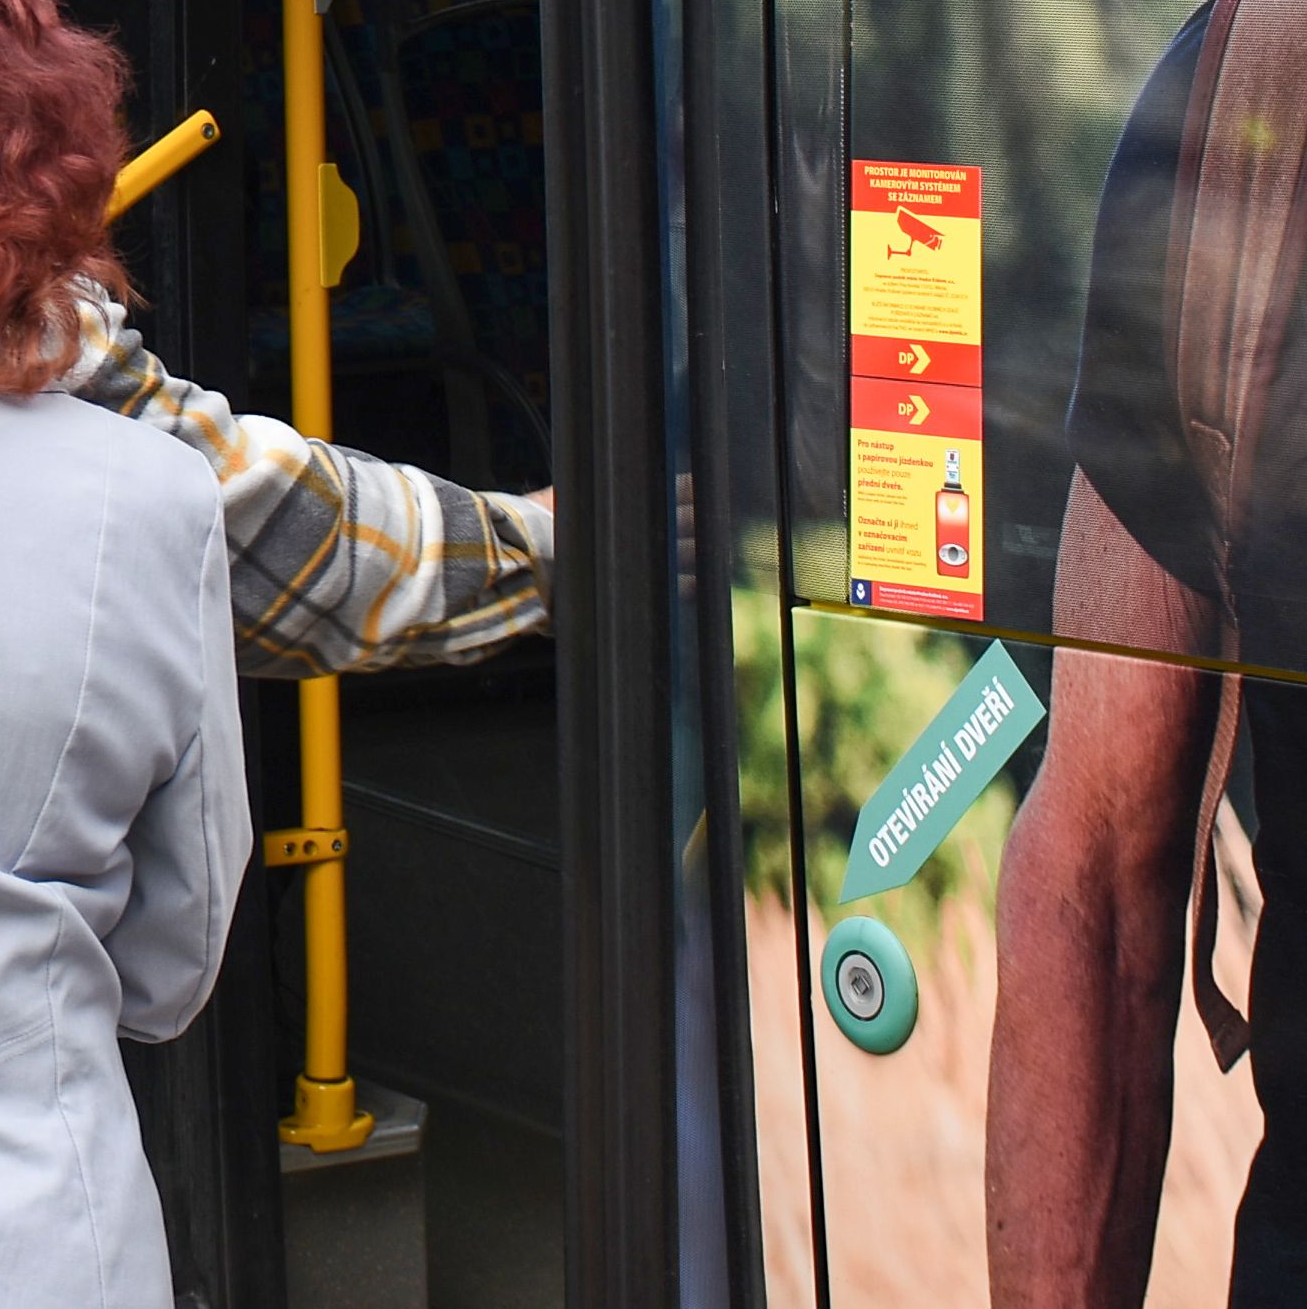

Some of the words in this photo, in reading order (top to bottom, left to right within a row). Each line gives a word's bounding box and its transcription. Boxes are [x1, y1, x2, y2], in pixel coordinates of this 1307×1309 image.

[864, 166, 898, 177] PROSTOR
[899, 168, 908, 178] JE
[909, 168, 967, 181] MONITOROVÁN
[870, 178, 919, 190] KAMEROVÝM
[919, 180, 961, 193] SYSTÉMEM
[888, 192, 897, 202] SE
[898, 192, 942, 204] ZÁZNAMEM
[898, 351, 915, 365] DP
[898, 402, 914, 416] DP
[858, 439, 869, 448] Pro
[868, 739, 962, 868] OTEVÍRÁNÍ
[953, 676, 1015, 761] DVEŘÍ
